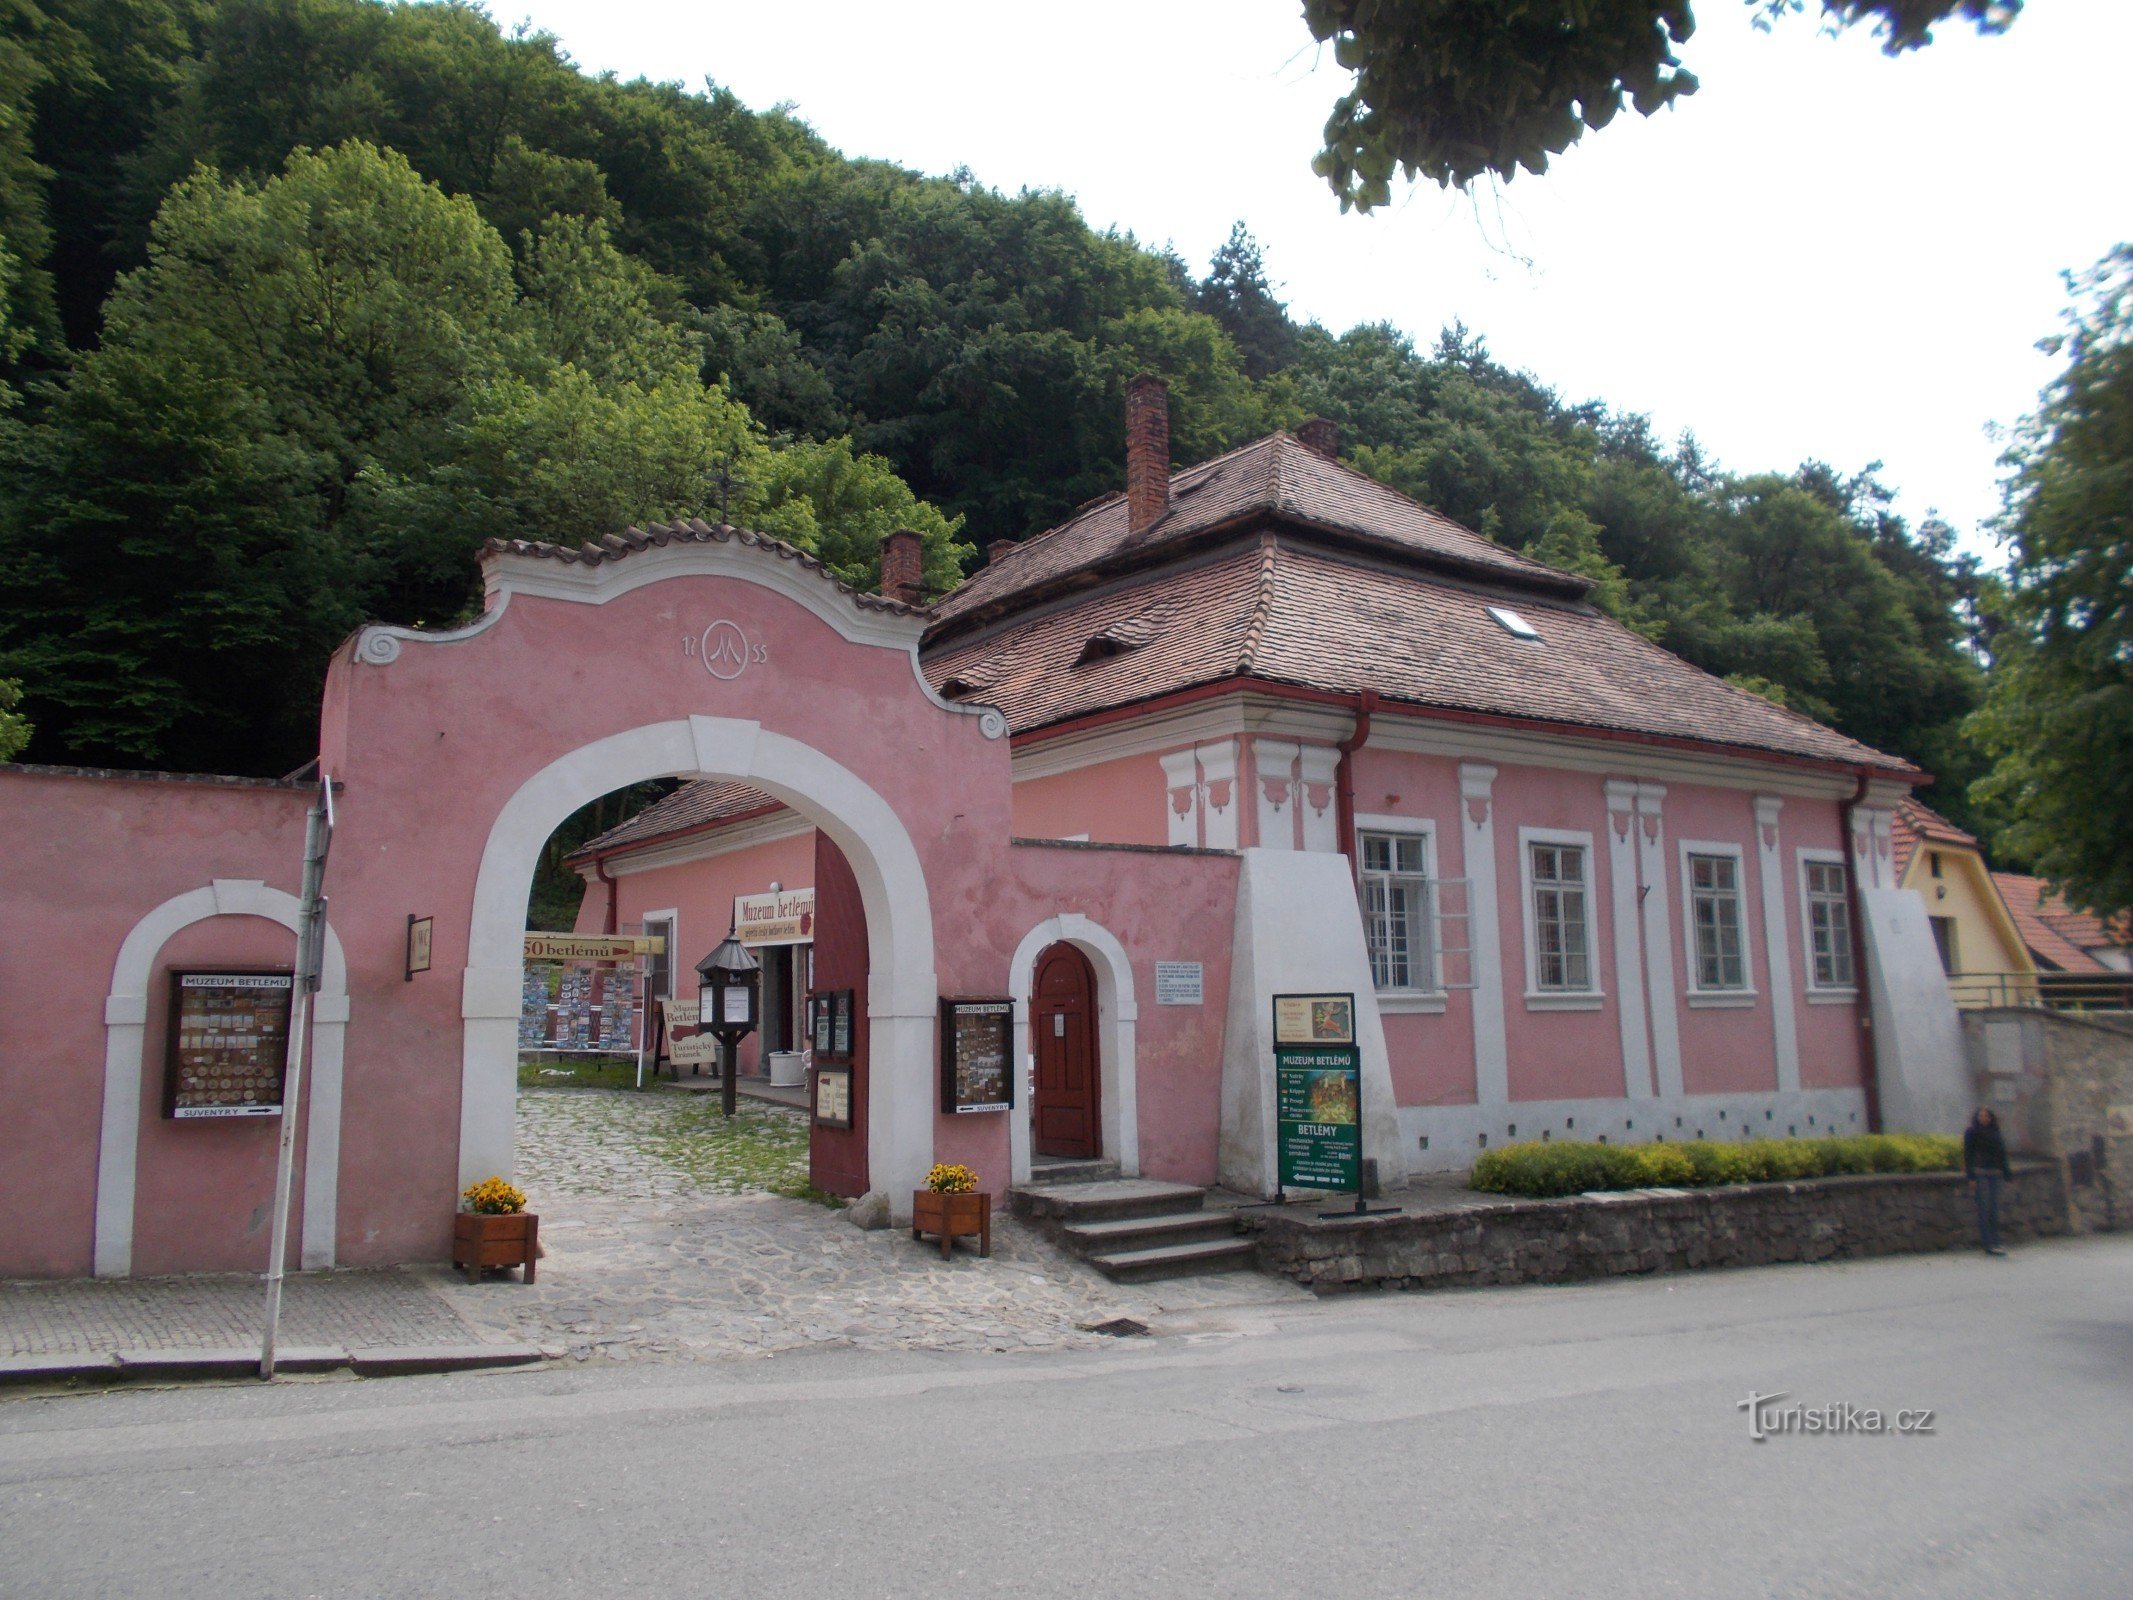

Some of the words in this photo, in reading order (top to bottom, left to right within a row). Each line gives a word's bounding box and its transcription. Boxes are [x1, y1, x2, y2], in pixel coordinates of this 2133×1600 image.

[742, 901, 775, 922] Muzeum
[546, 943, 610, 958] betlémů
[185, 977, 235, 987] MUZEUM
[673, 1005, 700, 1013] Muzeu
[955, 1005, 982, 1013] MUZEUM
[1282, 1056, 1315, 1065] MUZEUM
[1298, 1124, 1337, 1137] BETLÉMY
